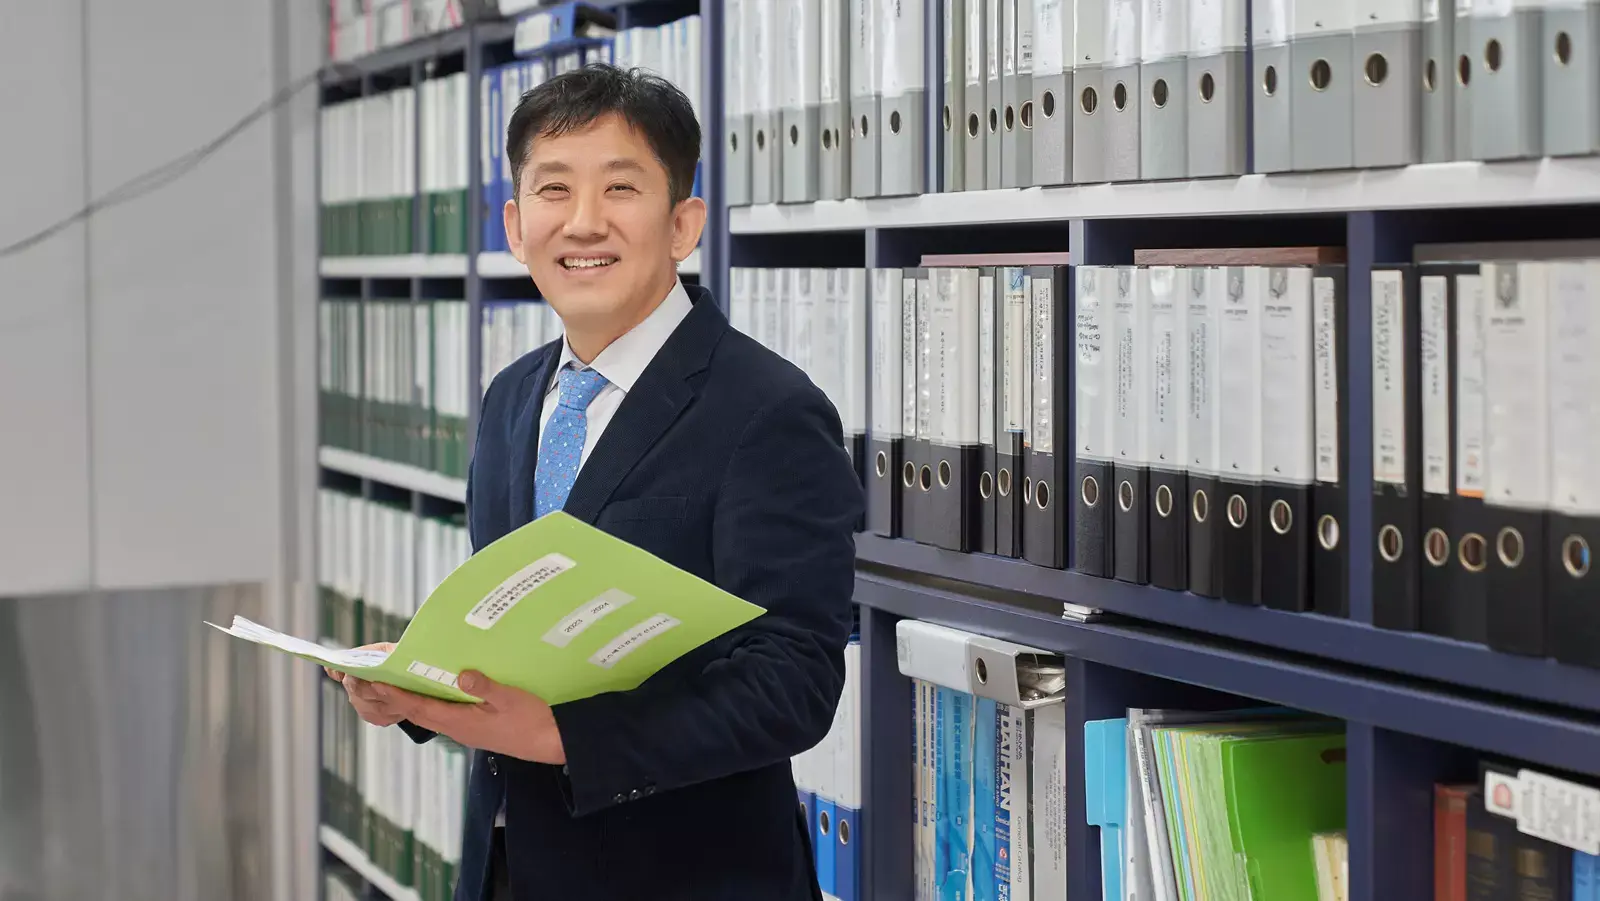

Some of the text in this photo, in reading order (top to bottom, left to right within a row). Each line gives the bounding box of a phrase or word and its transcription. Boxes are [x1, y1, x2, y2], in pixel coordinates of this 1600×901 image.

[564, 602, 609, 633] 2023 2024
[1000, 715, 1011, 811] DAIHAN
